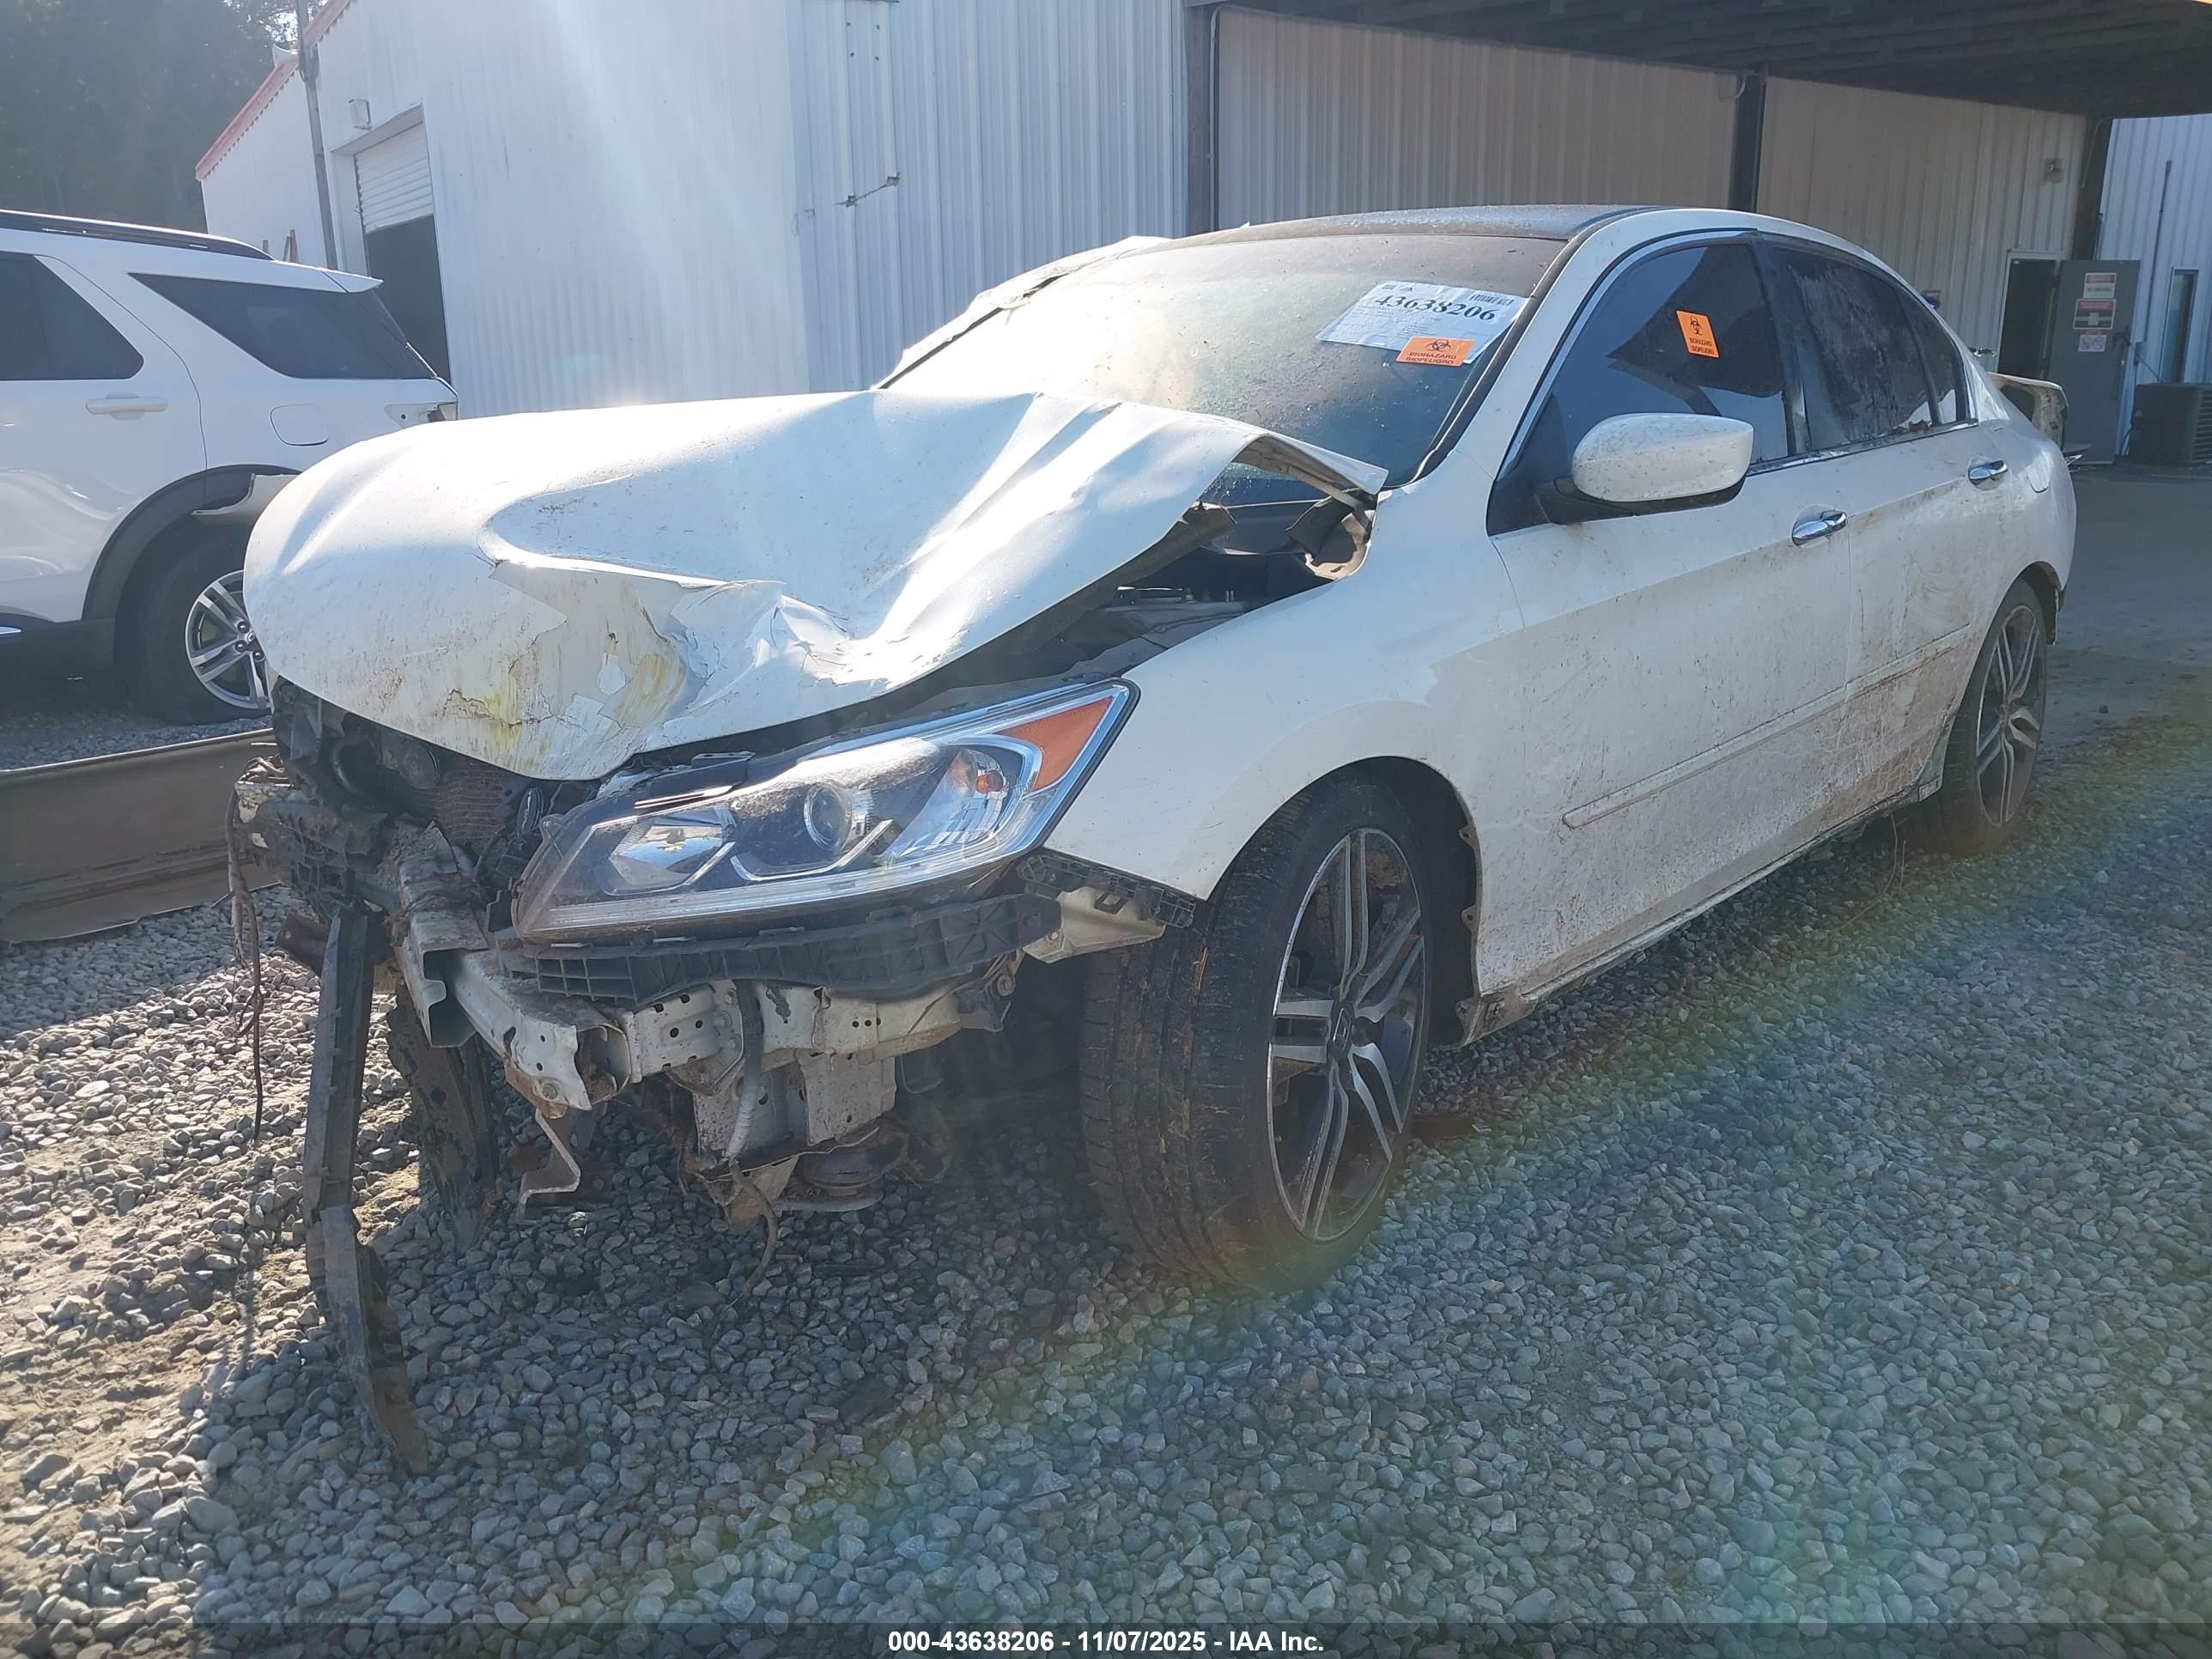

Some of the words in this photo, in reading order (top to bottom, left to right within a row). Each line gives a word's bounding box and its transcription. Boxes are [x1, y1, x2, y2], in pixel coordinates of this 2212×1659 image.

[1375, 295, 1500, 321] 43638206
[1408, 351, 1457, 360] BIOHAZARD
[1405, 356, 1455, 365] BIOPELIGRO
